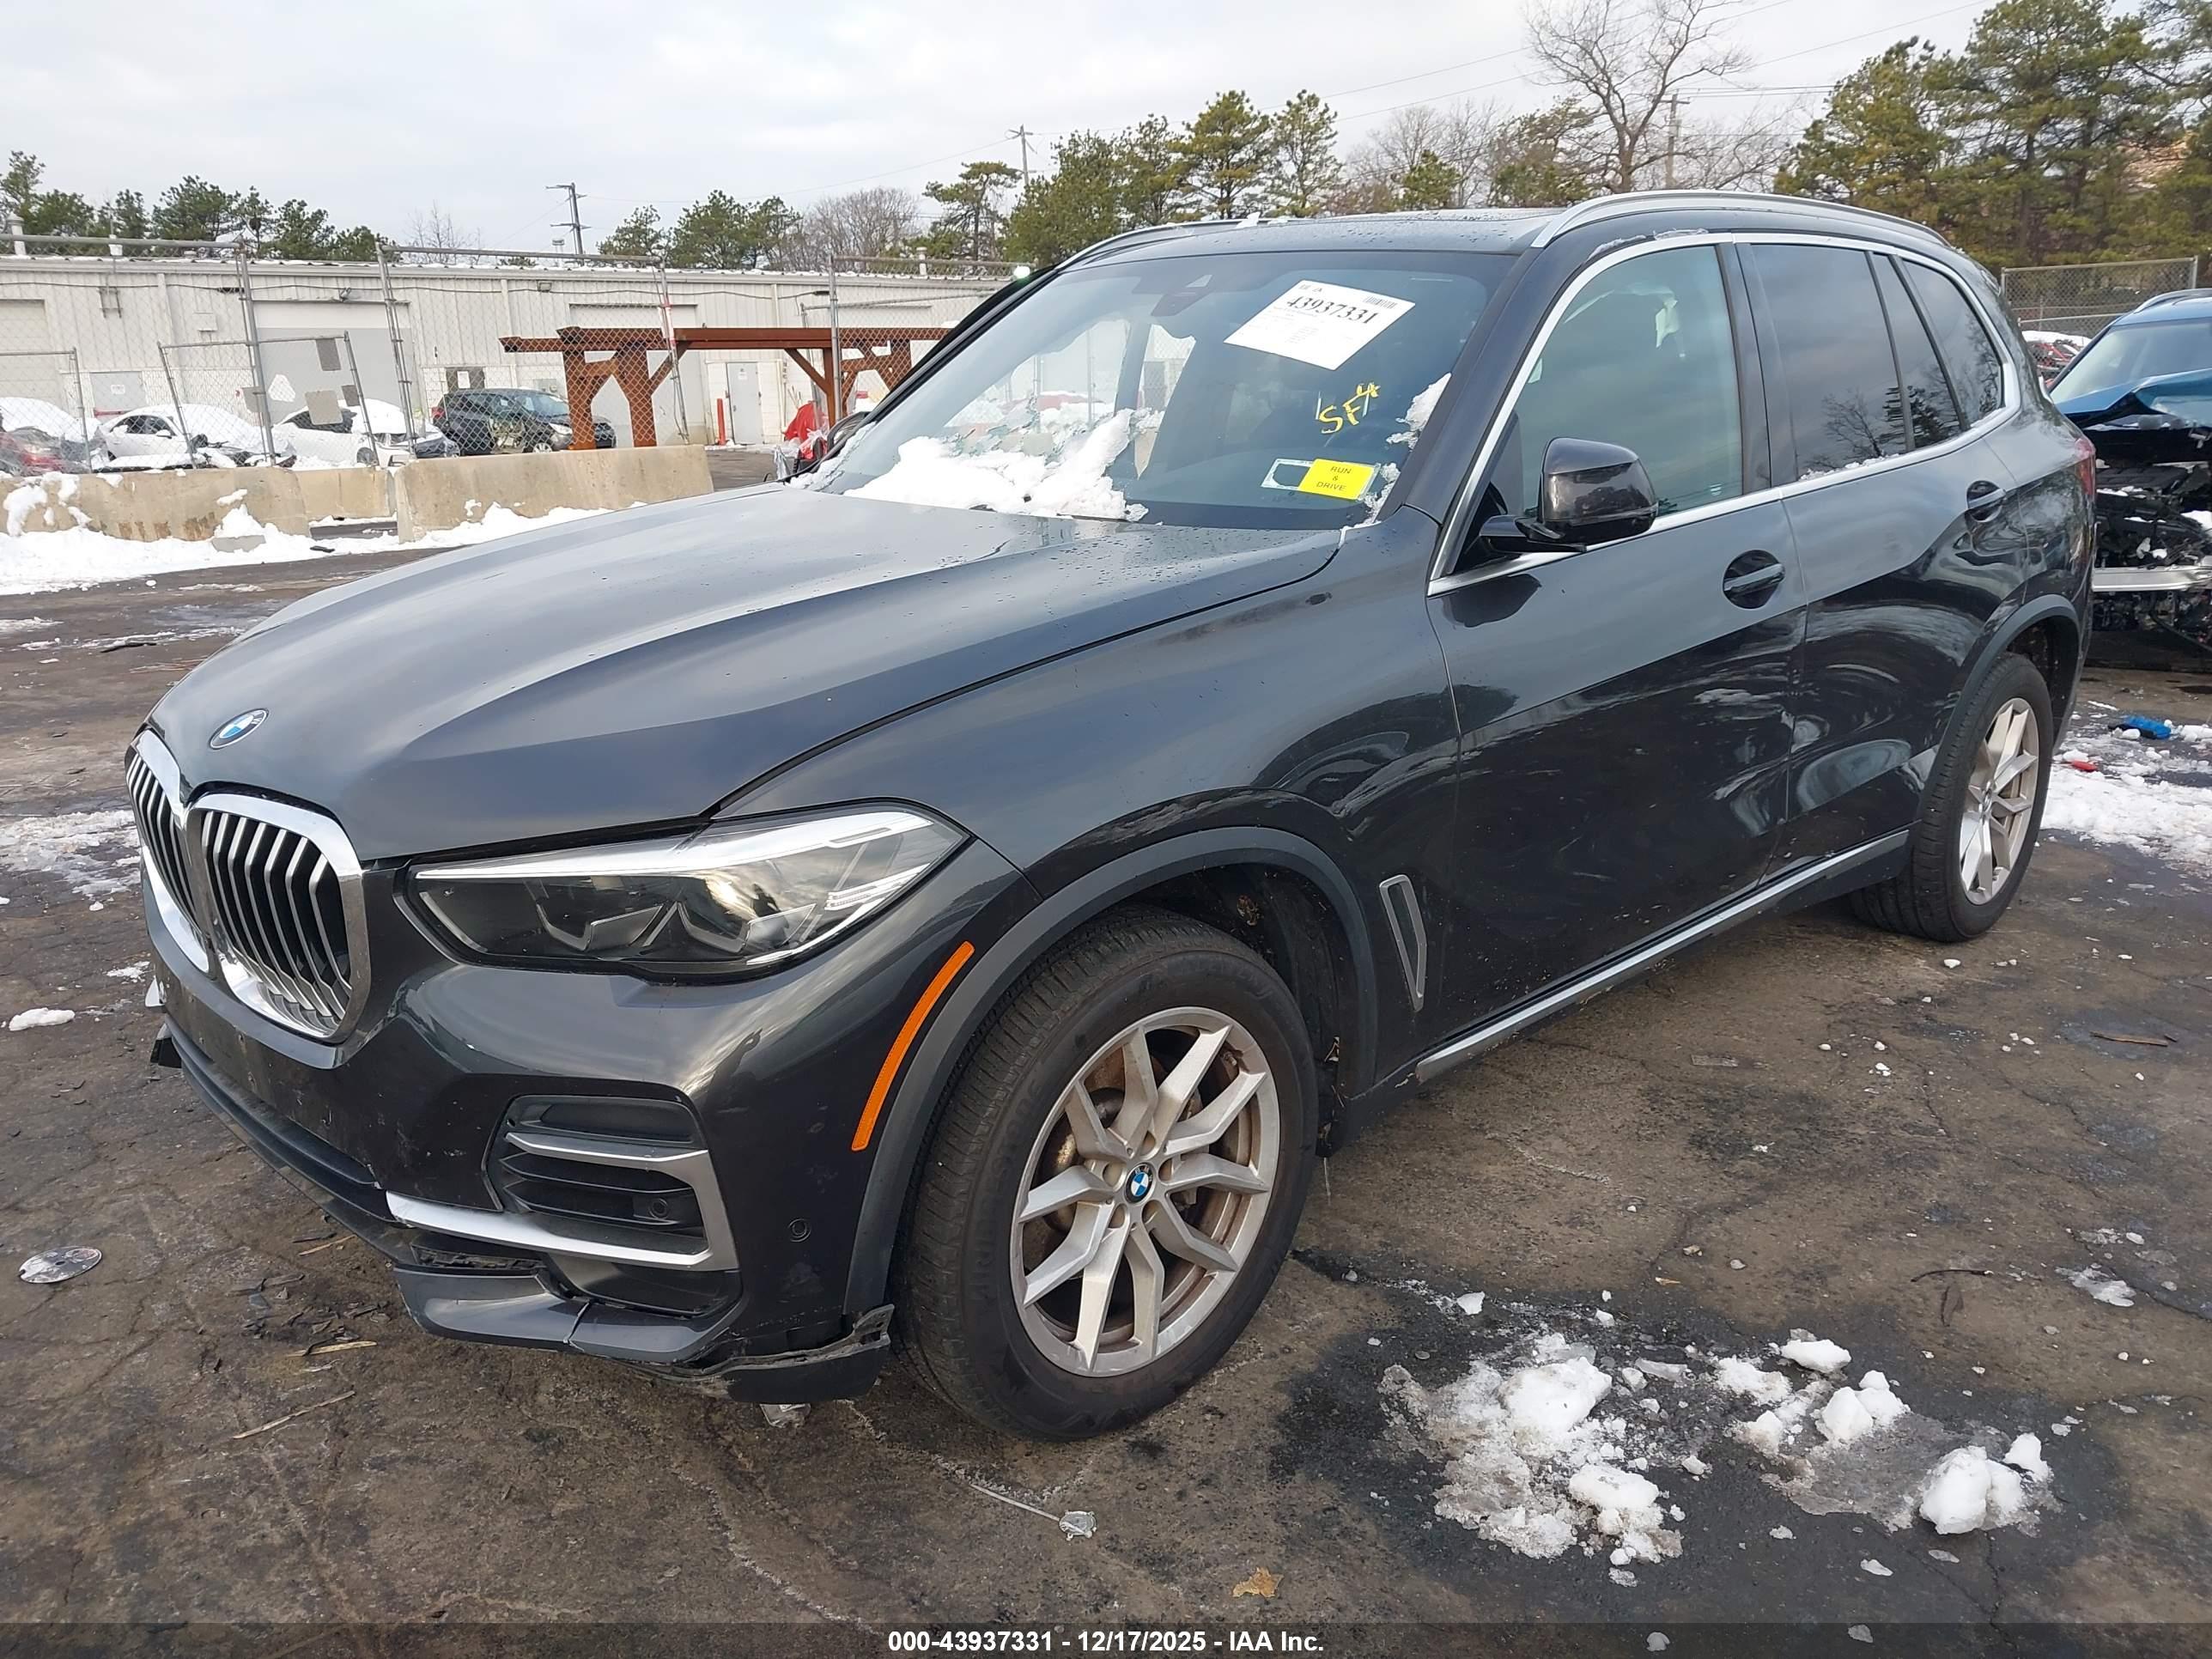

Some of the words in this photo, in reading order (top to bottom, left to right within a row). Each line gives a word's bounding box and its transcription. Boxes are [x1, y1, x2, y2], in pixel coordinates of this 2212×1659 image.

[1287, 296, 1378, 324] 43937331
[1330, 465, 1352, 474] RUN
[1316, 481, 1346, 491] DRIVE
